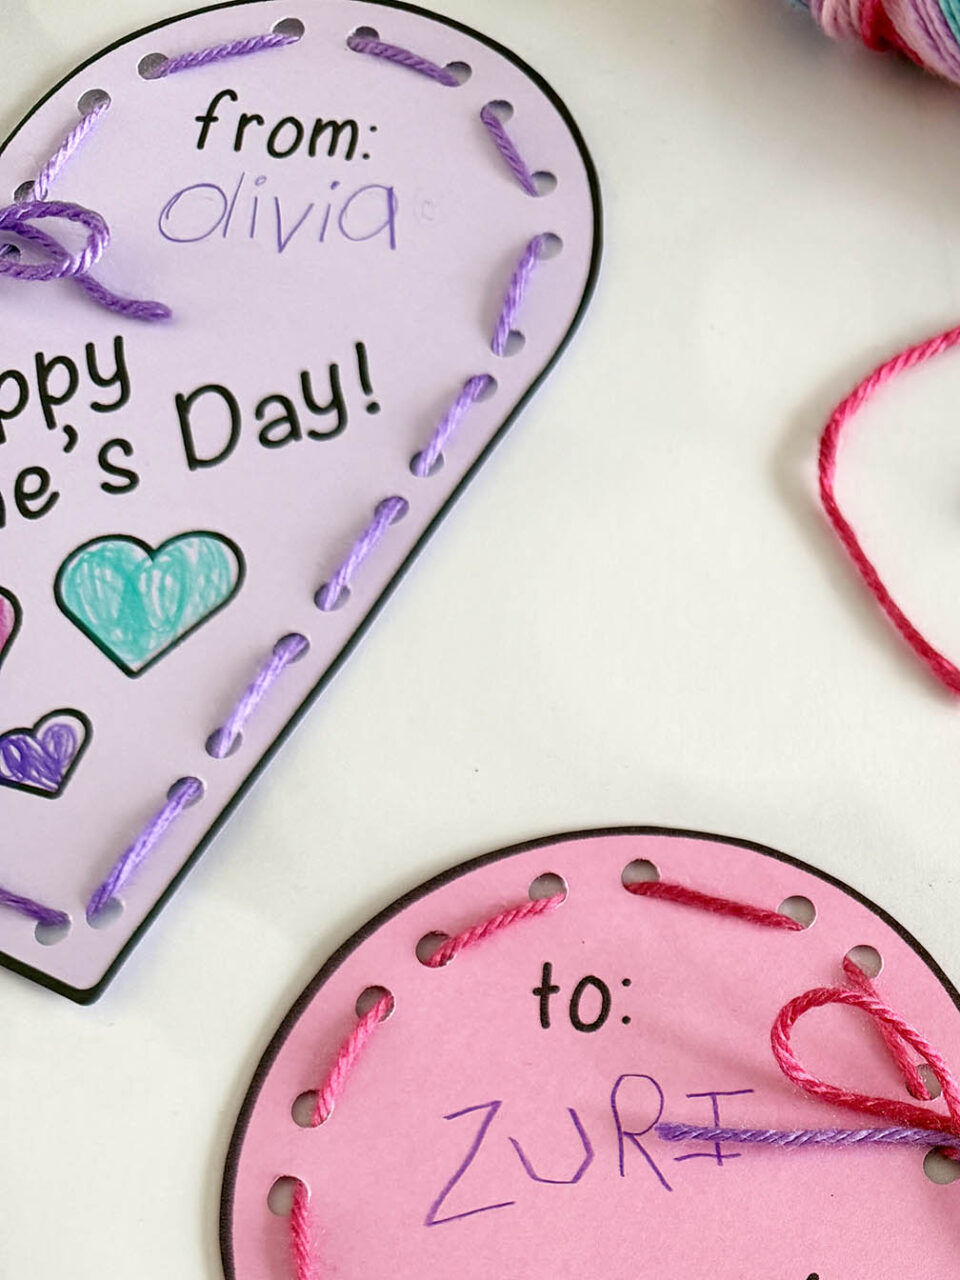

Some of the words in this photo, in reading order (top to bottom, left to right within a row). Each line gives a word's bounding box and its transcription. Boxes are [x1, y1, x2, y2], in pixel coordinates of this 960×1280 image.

[194, 88, 378, 161] from:
[175, 341, 380, 471] Day!
[533, 961, 632, 1032] to:
[425, 1073, 754, 1226] ZURI
